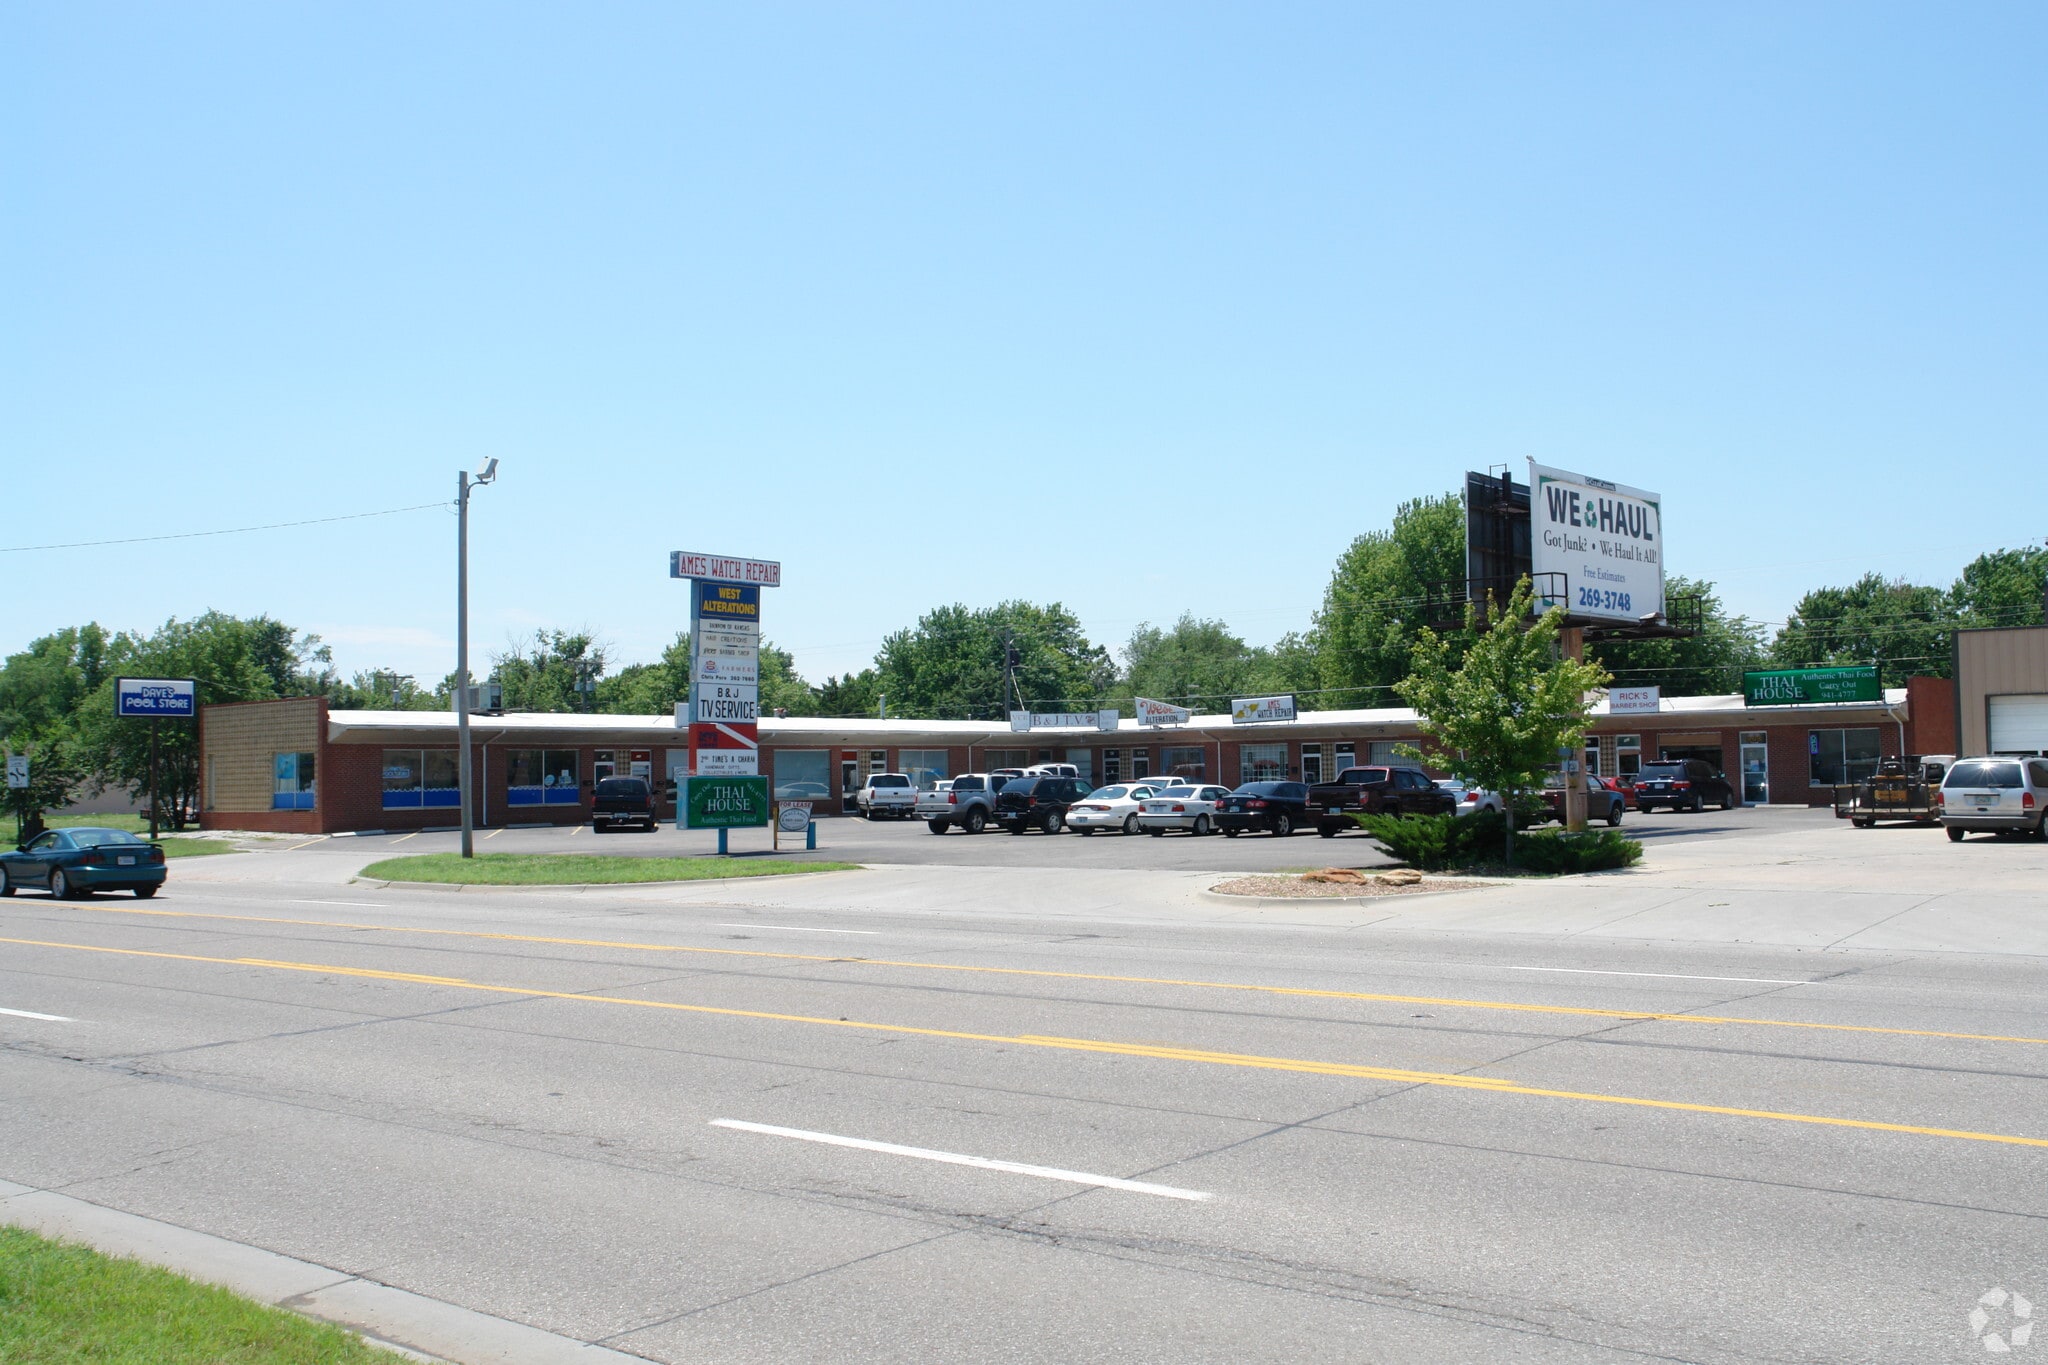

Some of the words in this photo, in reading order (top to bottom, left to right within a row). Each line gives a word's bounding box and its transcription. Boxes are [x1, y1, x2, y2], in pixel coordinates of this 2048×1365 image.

[1546, 486, 1581, 527] WE
[1599, 498, 1653, 541] HAUL
[1544, 530, 1562, 550] Got
[1563, 534, 1587, 552] Junk?
[1600, 540, 1613, 557] We
[1615, 542, 1634, 560] Haul
[1636, 547, 1643, 561] It
[1644, 548, 1657, 564] All!
[681, 556, 706, 576] AMES
[711, 559, 741, 579] WATCH
[746, 562, 779, 583] REPAIR
[1584, 565, 1596, 579] Free
[1598, 569, 1626, 583] Estimates
[718, 588, 741, 600] WEST
[1579, 587, 1631, 611] 269-3748
[703, 601, 755, 615] ALTERATIONS
[1801, 672, 1836, 681] Authentic
[1838, 671, 1854, 680] Thai
[1856, 670, 1876, 678] Food
[1760, 676, 1795, 689] THAI
[1818, 682, 1839, 692] Carry
[1842, 681, 1857, 689] Out
[143, 687, 174, 699] DAVE'S
[717, 688, 724, 698] B
[725, 688, 733, 698] &
[734, 689, 740, 699] J
[1619, 692, 1648, 701] RICK'S
[1754, 687, 1804, 700] HOUSE
[127, 698, 156, 708] POOL
[159, 699, 189, 709] STORE
[701, 700, 715, 718] TV
[716, 701, 755, 720] SERVICE
[1267, 700, 1281, 710] AMES
[1257, 709, 1273, 720] WATCH
[1275, 707, 1292, 719] REPAIR
[1033, 715, 1041, 726] B
[1043, 718, 1052, 726] &
[714, 786, 744, 799] THAI
[707, 798, 751, 811] HOUSE
[701, 816, 728, 824] Authentic
